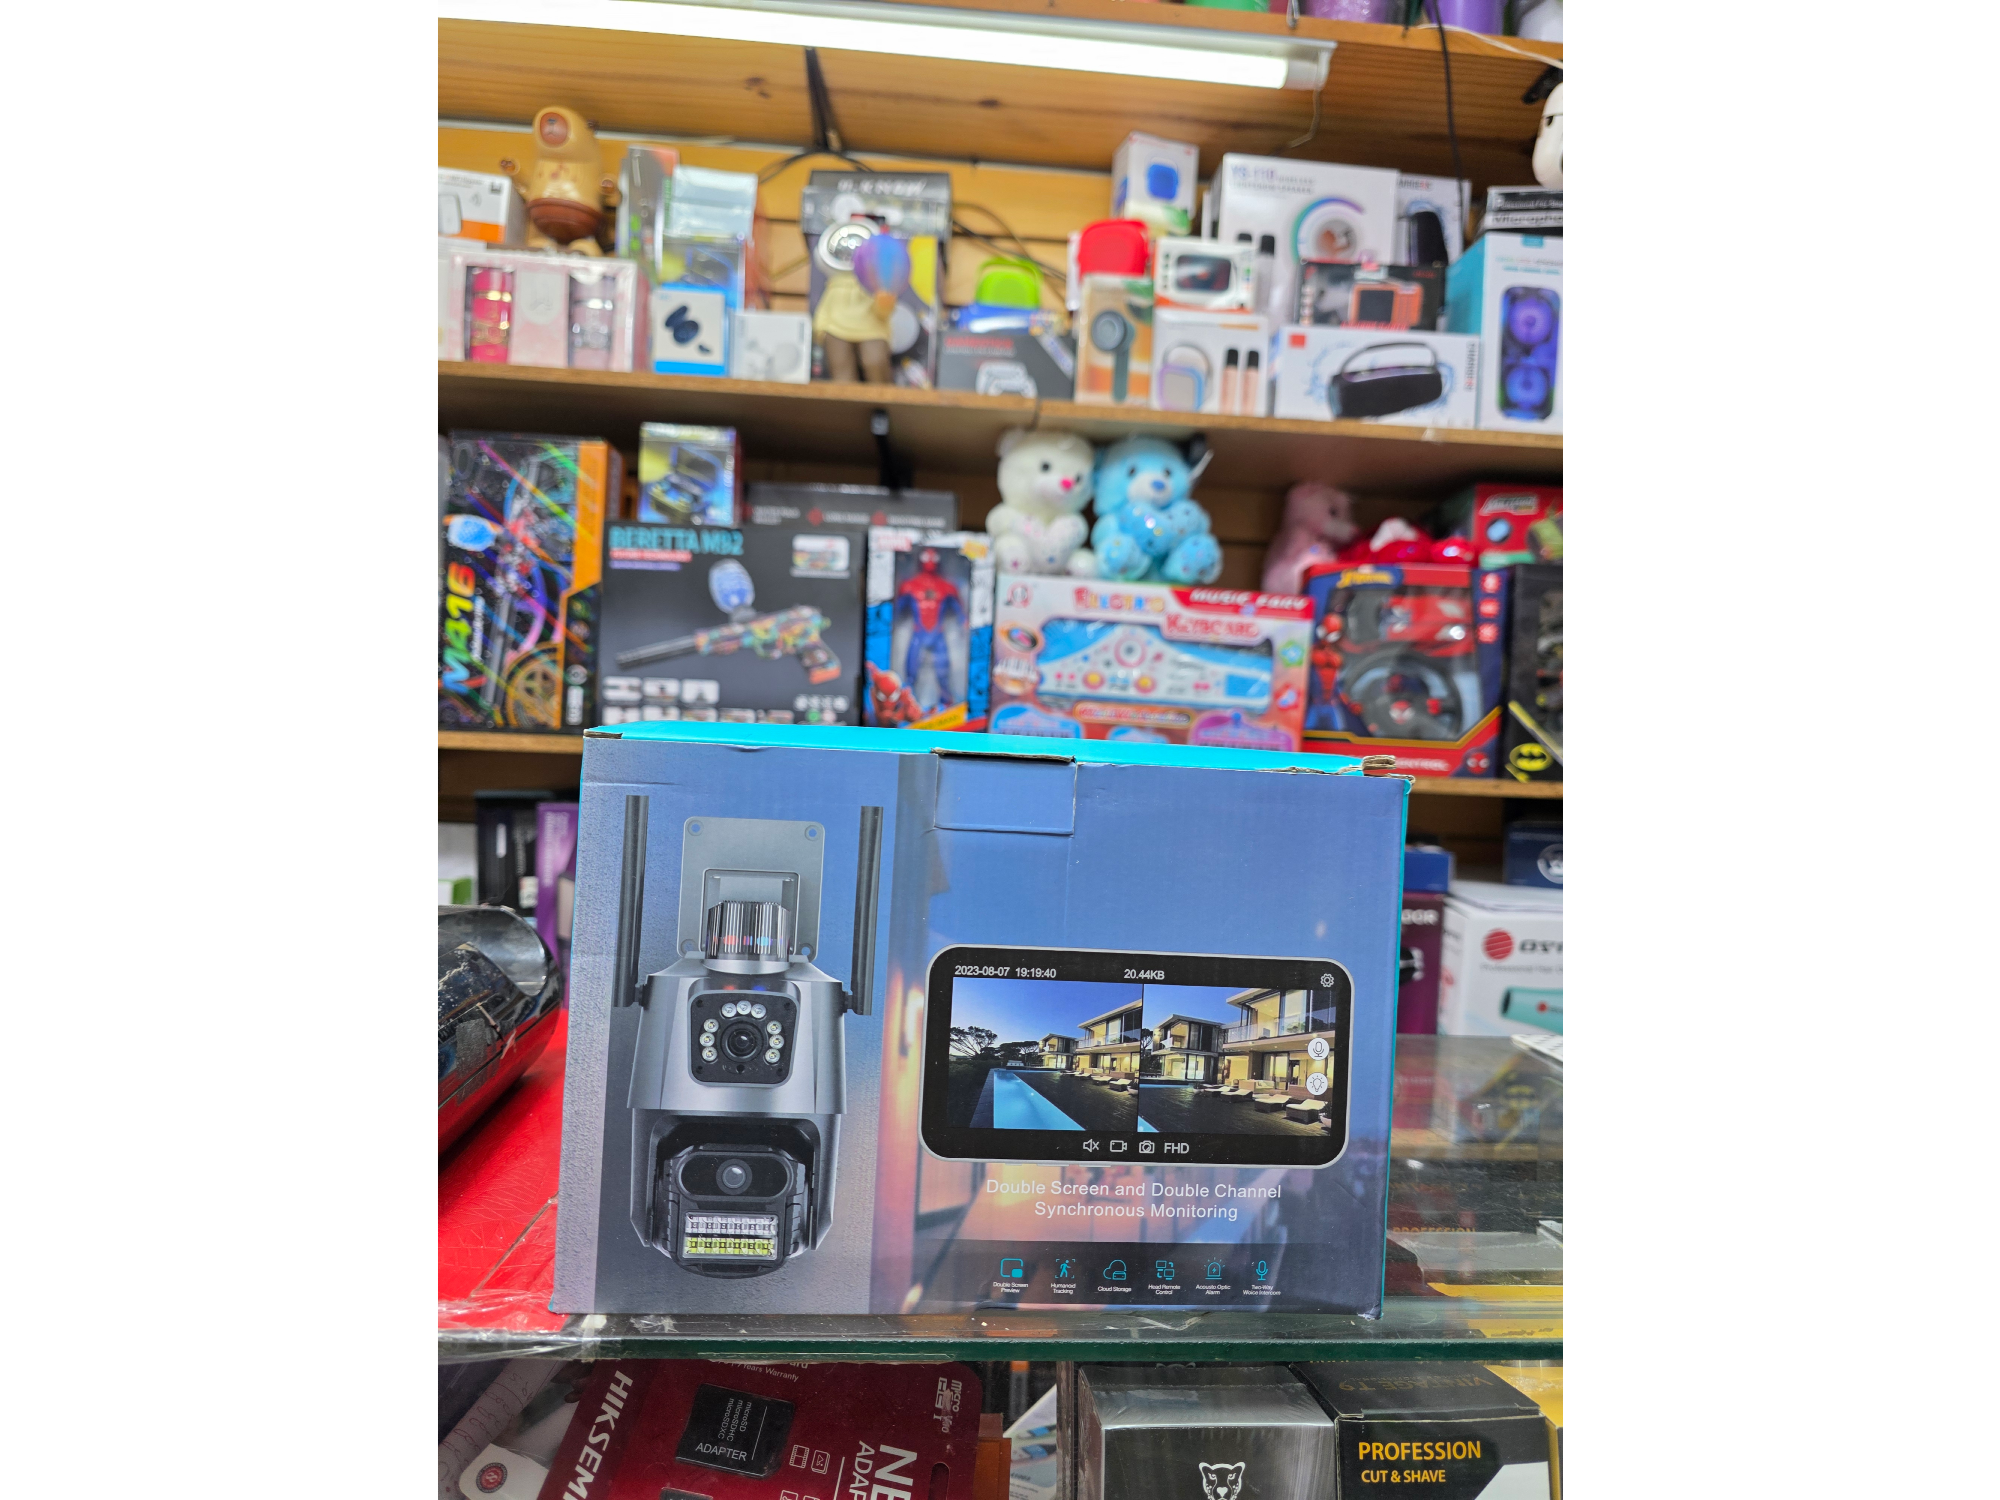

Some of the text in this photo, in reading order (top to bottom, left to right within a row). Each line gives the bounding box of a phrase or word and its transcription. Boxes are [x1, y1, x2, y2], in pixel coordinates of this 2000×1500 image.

[954, 965, 1165, 981] 2023-08-07 19:19:40 20.44KB
[1164, 1142, 1190, 1154] FHD
[986, 1179, 1281, 1199] Double Screen and Double Channel
[1034, 1201, 1238, 1222] Synchronous Monitoring
[765, 1367, 799, 1382] Warranty
[717, 1398, 735, 1440] microSDXC
[726, 1399, 744, 1442] microSDHC
[739, 1401, 752, 1433] microSD
[695, 1442, 748, 1462] ADAPTER
[1358, 1440, 1481, 1461] PROFESSION
[1361, 1469, 1446, 1483] CUT & SHAVE
